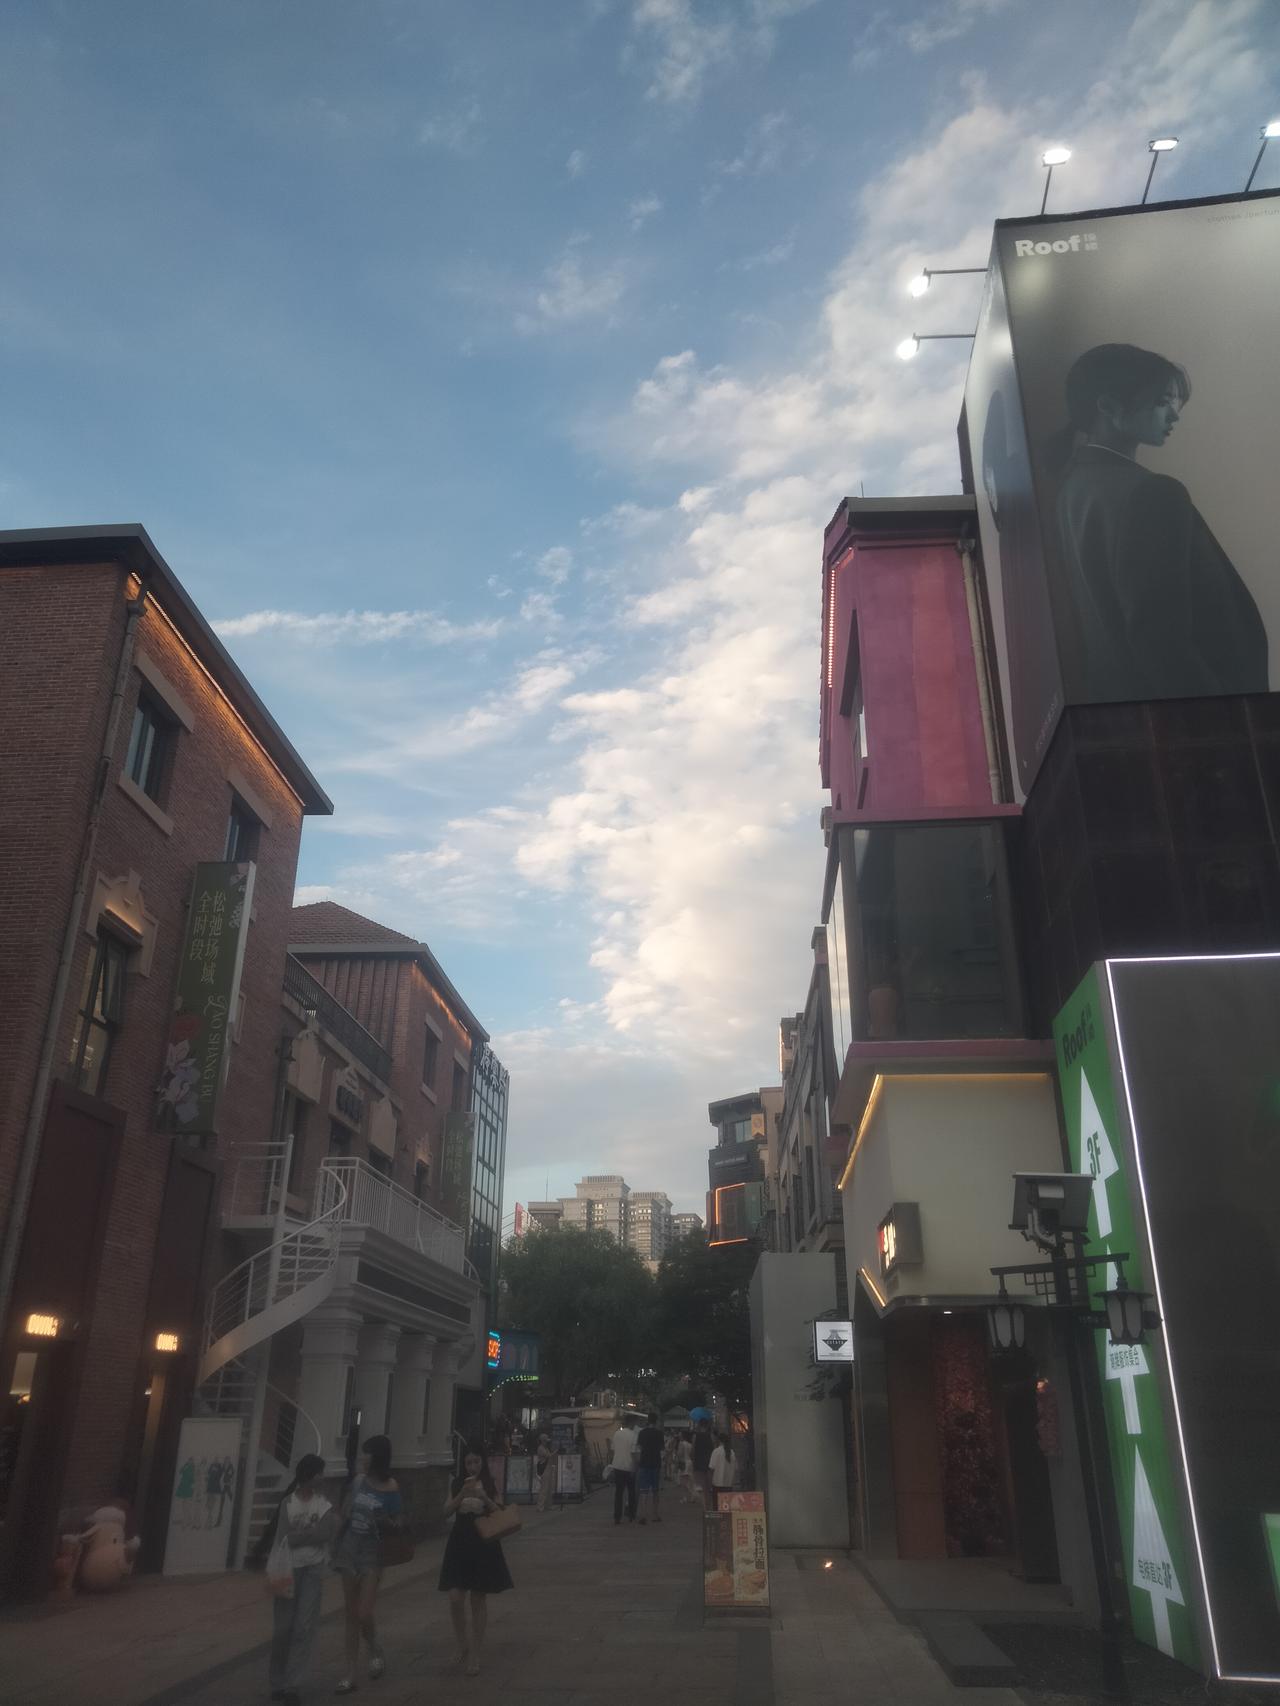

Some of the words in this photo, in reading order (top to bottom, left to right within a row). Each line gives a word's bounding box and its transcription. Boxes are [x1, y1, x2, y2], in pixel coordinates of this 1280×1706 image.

[1015, 234, 1080, 256] Roof
[1062, 1012, 1088, 1068] Roof
[1087, 1131, 1101, 1180] 3F
